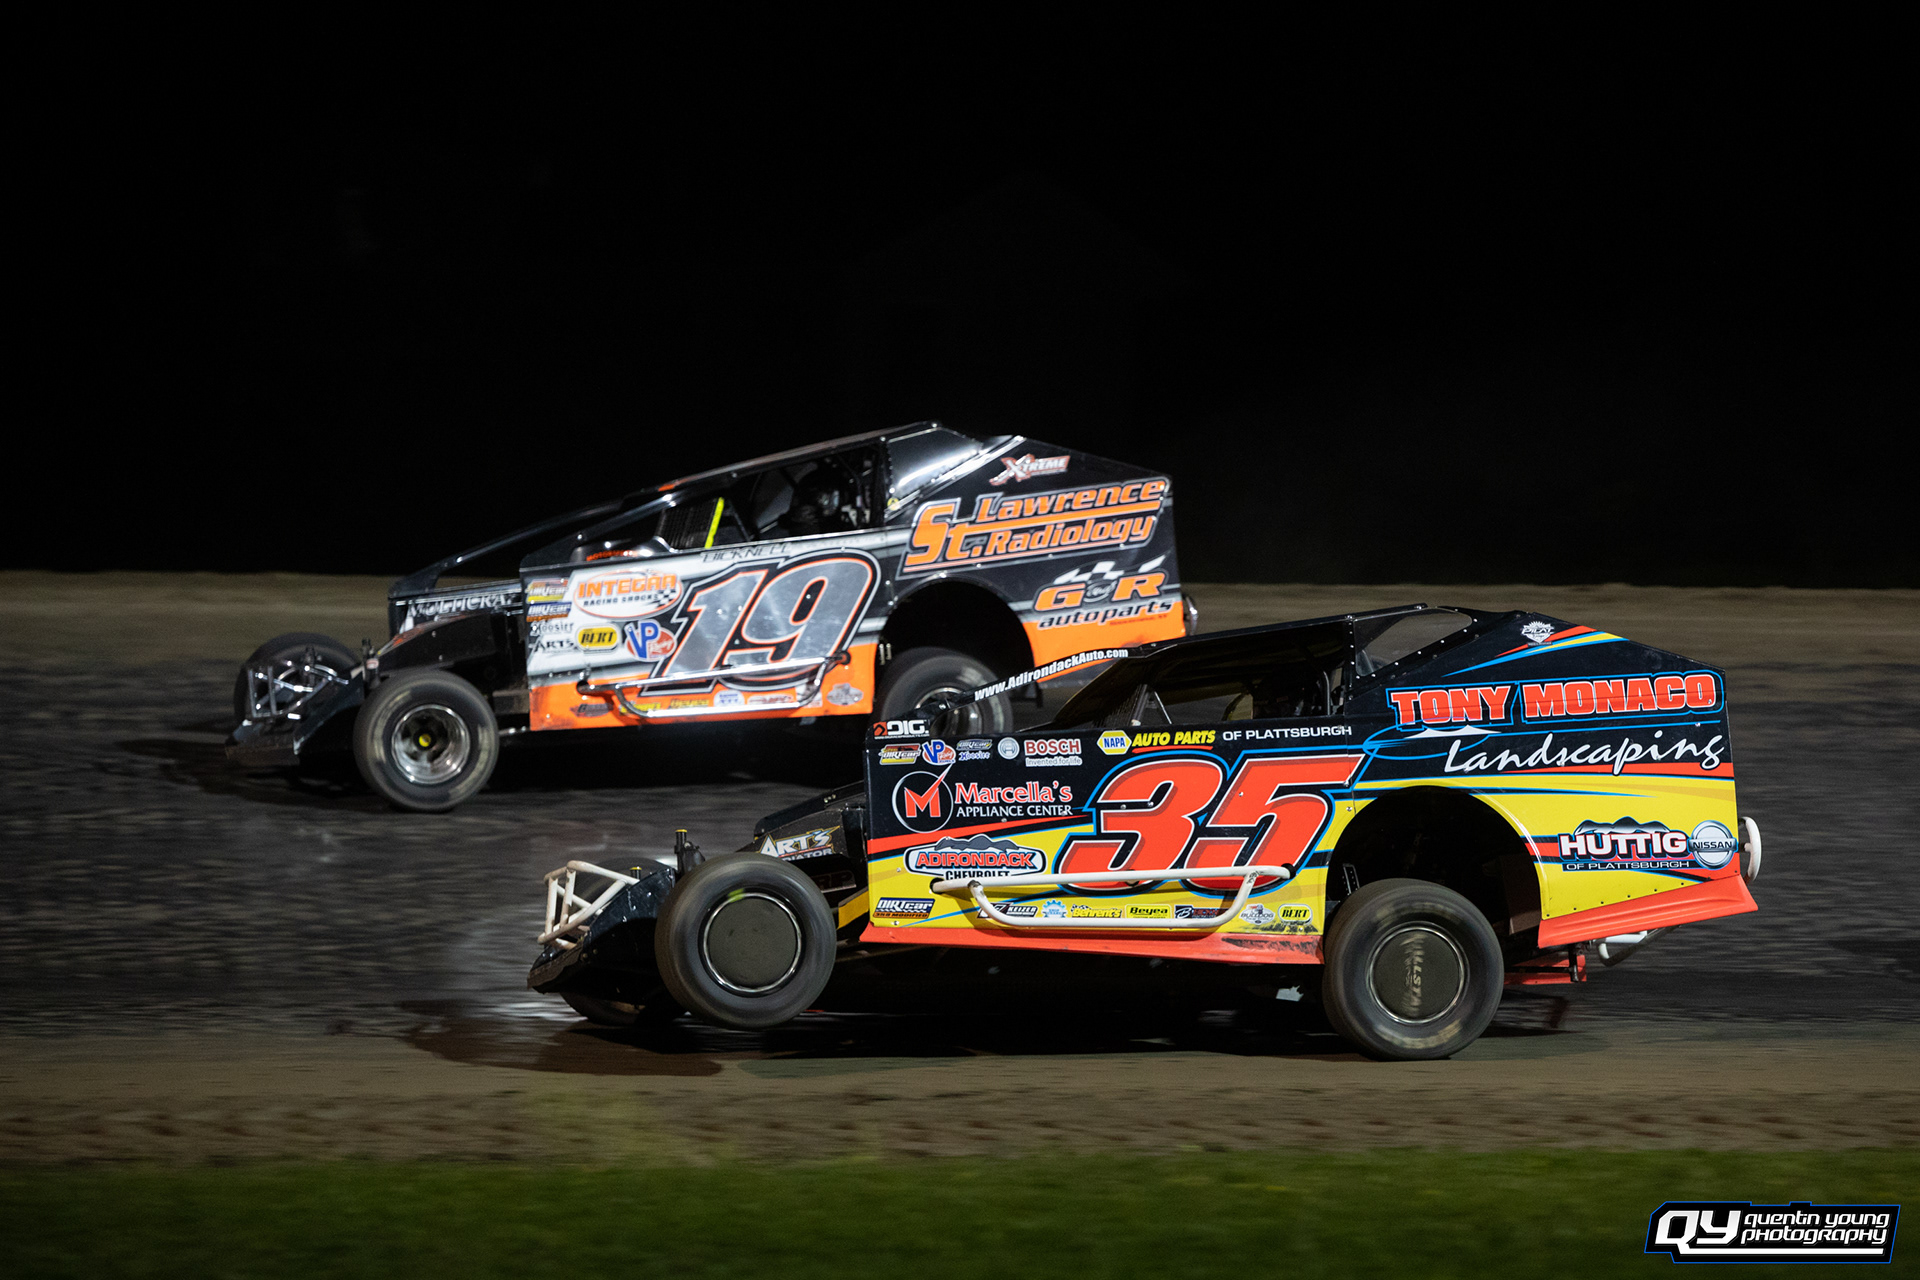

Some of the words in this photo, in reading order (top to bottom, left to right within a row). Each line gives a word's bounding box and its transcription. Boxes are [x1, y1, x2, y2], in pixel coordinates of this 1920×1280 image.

[904, 503, 983, 567] St.
[975, 480, 1166, 523] Lawrence
[985, 515, 1156, 556] Radiology
[578, 573, 677, 598] INTEGRA
[1034, 583, 1086, 611] G
[1112, 572, 1167, 602] R
[584, 598, 618, 607] RACING
[661, 557, 873, 682] 19
[1038, 600, 1174, 629] autoparts
[628, 621, 659, 659] VP
[974, 648, 1129, 702] www.AdirondackAuto.com
[1391, 685, 1511, 725] TONY
[1522, 674, 1717, 718] MONACO
[1025, 740, 1081, 754] BOSCH
[1103, 736, 1126, 748] NAPA
[1132, 732, 1171, 747] AUTO
[1174, 730, 1216, 745] PARTS
[1222, 731, 1242, 741] OF
[1246, 726, 1352, 740] PLATTSBURGH
[923, 740, 945, 764] VP
[1026, 756, 1058, 766] Invented
[1058, 756, 1069, 765] for
[1070, 756, 1082, 764] life
[1443, 730, 1725, 777] Landscaping
[954, 781, 1073, 804] Marcella's
[956, 805, 1024, 817] APPLIANCE
[1027, 804, 1073, 816] CENTER
[1059, 754, 1365, 891] 35
[781, 848, 833, 861] DIATOR
[1559, 832, 1688, 857] HUTTIG
[1692, 840, 1733, 849] NISSAN
[915, 852, 1034, 869] ADIRONDACK
[1588, 861, 1690, 870] PLATTSBURGH
[877, 900, 932, 912] DIRTcar
[1008, 905, 1037, 913] KEIZER
[1129, 906, 1168, 915] Beyea
[1282, 909, 1310, 918] BERT
